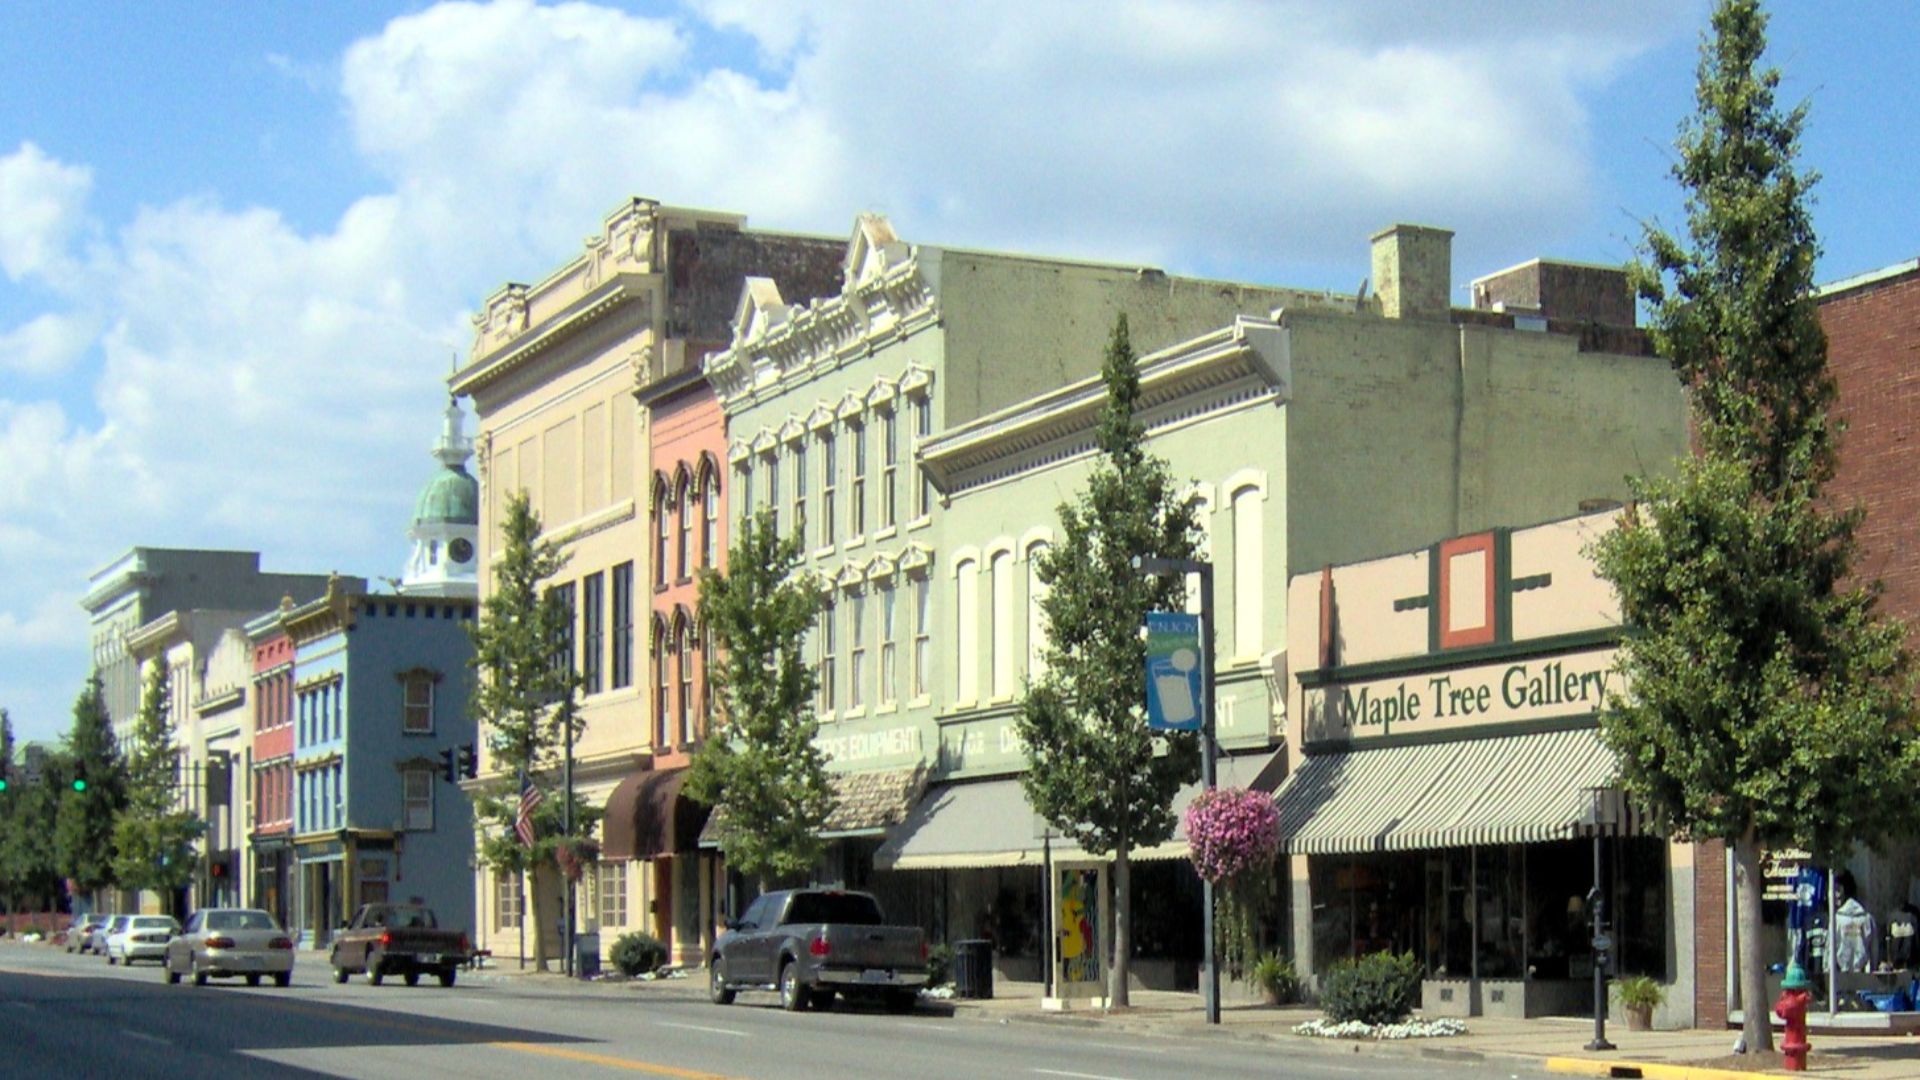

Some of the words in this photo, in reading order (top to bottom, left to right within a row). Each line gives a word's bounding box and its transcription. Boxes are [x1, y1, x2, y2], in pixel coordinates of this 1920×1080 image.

[1215, 695, 1237, 728] NT
[1342, 682, 1420, 734] Maple
[1429, 675, 1490, 718] Tree
[1502, 661, 1611, 713] Gallery
[849, 726, 917, 759] EQUIPMENT
